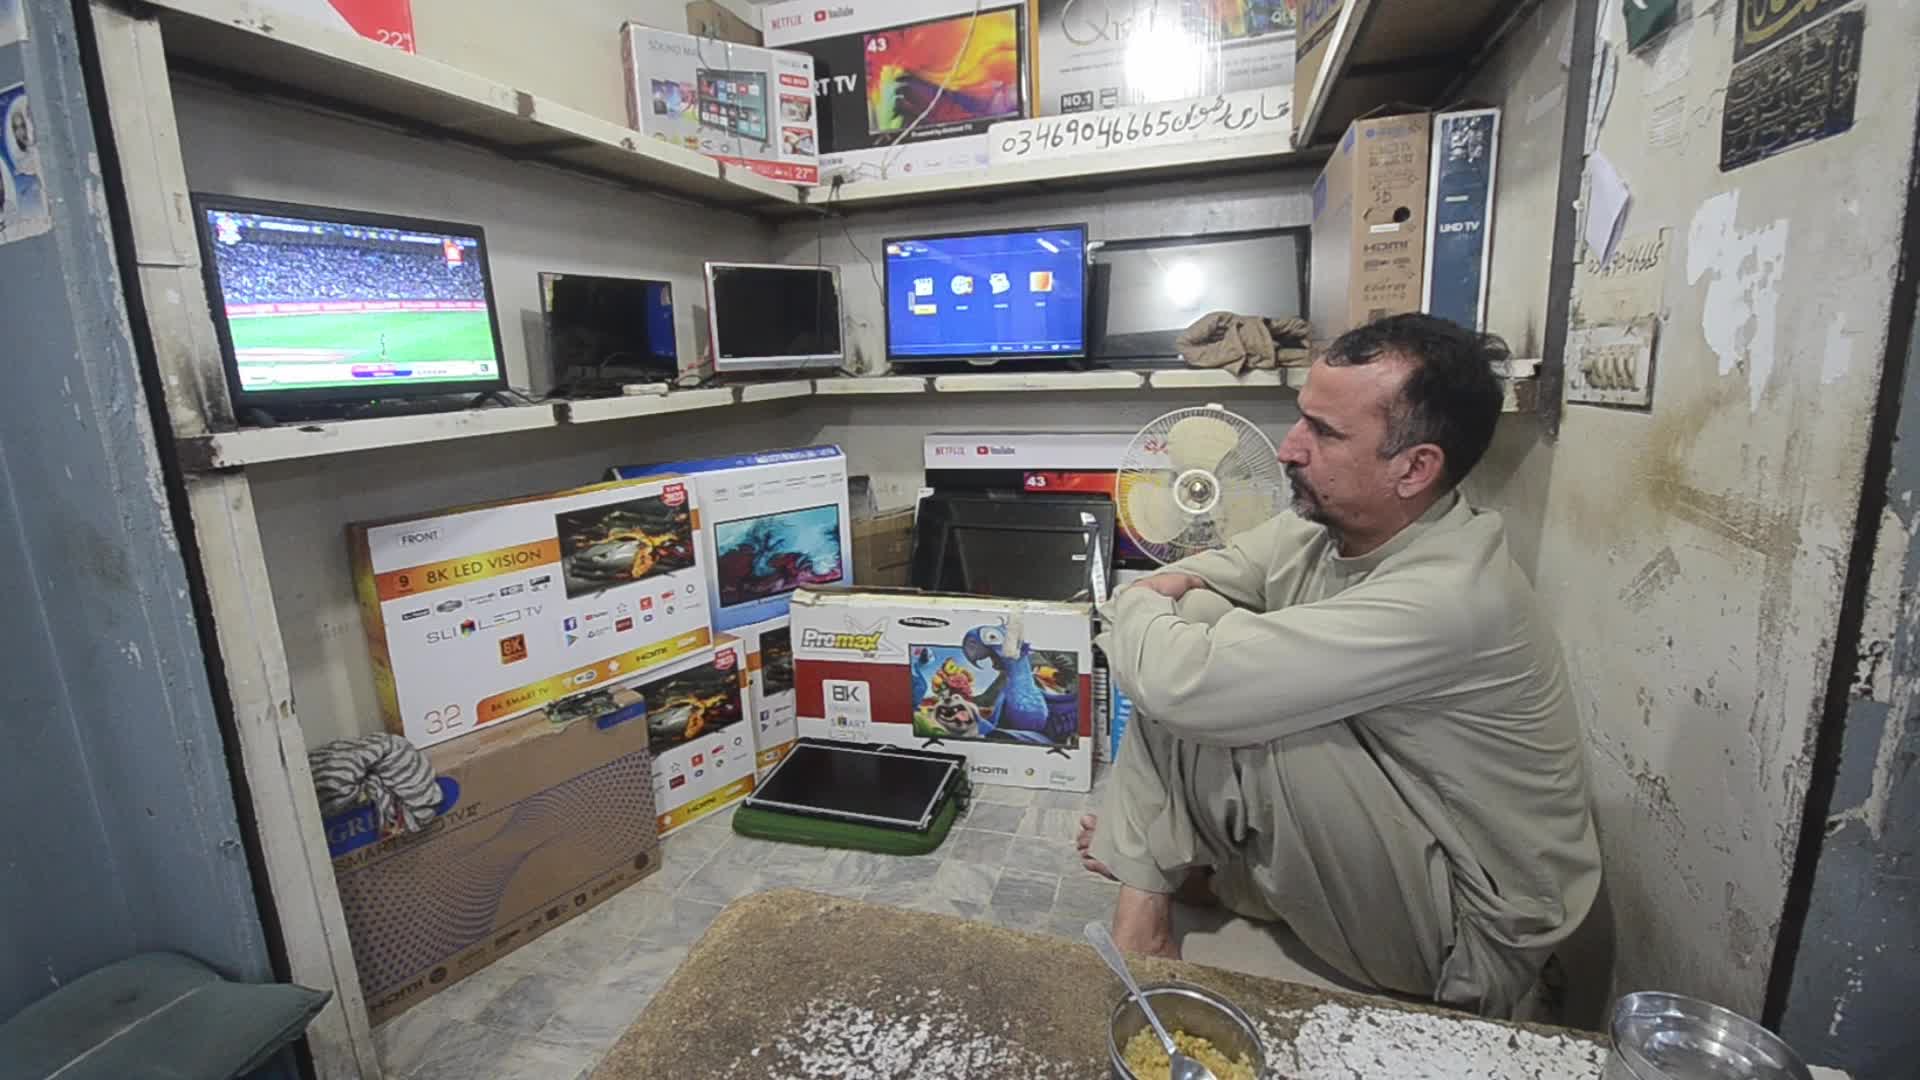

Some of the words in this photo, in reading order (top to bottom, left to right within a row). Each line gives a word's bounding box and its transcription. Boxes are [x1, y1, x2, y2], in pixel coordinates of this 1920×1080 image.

[867, 38, 887, 52] 43
[833, 75, 857, 96] TV
[1062, 94, 1092, 108] NO.1
[1002, 110, 1172, 156] 03469046665
[1440, 222, 1463, 233] UHD
[1464, 220, 1480, 231] TV
[1026, 476, 1047, 487] 43
[402, 530, 438, 545] FRONT
[426, 567, 449, 584] 8K
[454, 561, 483, 578] LED
[488, 548, 542, 569] VISION
[801, 628, 883, 651] Promax
[424, 704, 463, 735] 32
